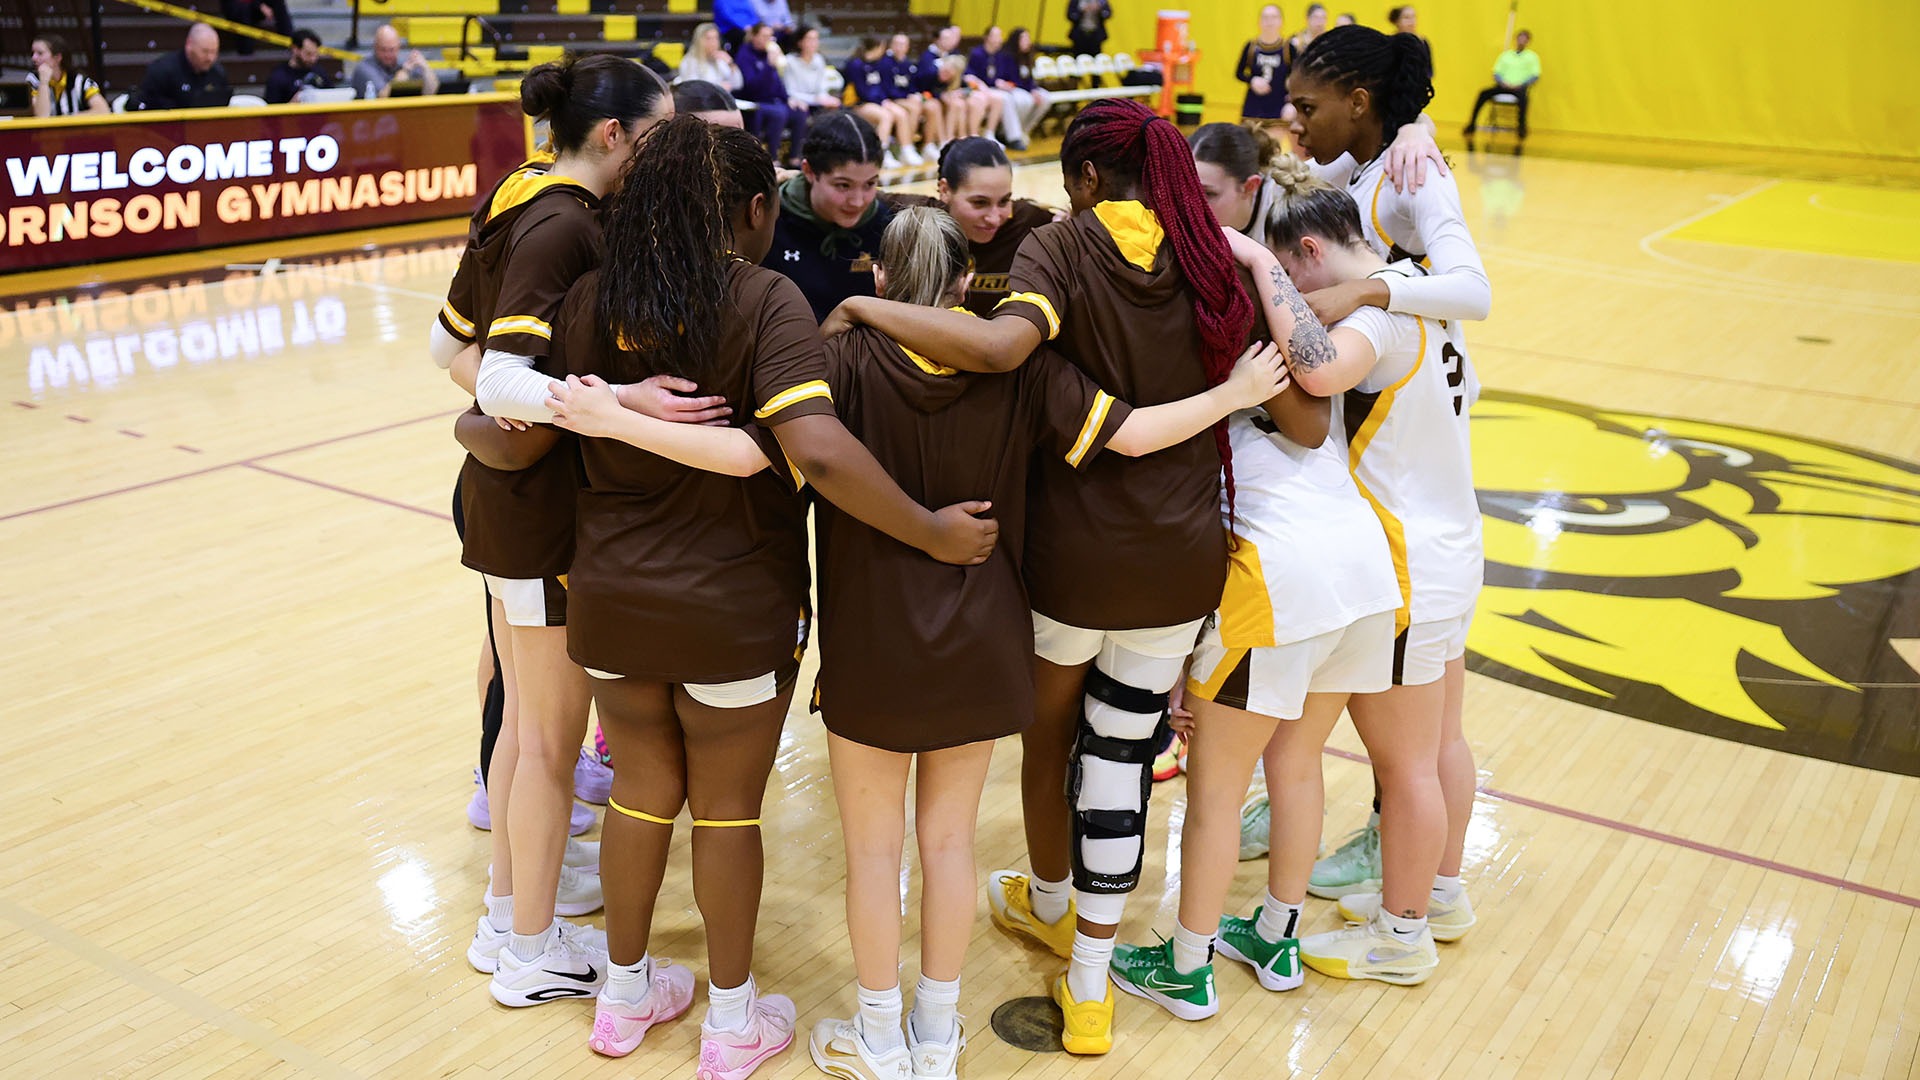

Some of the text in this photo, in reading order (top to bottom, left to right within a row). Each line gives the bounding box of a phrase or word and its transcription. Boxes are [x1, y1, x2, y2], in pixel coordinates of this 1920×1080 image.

[6, 134, 340, 197] WELCOME TO
[0, 163, 478, 247] RNSON GYMNASIUM
[1091, 880, 1135, 889] DONJOY
